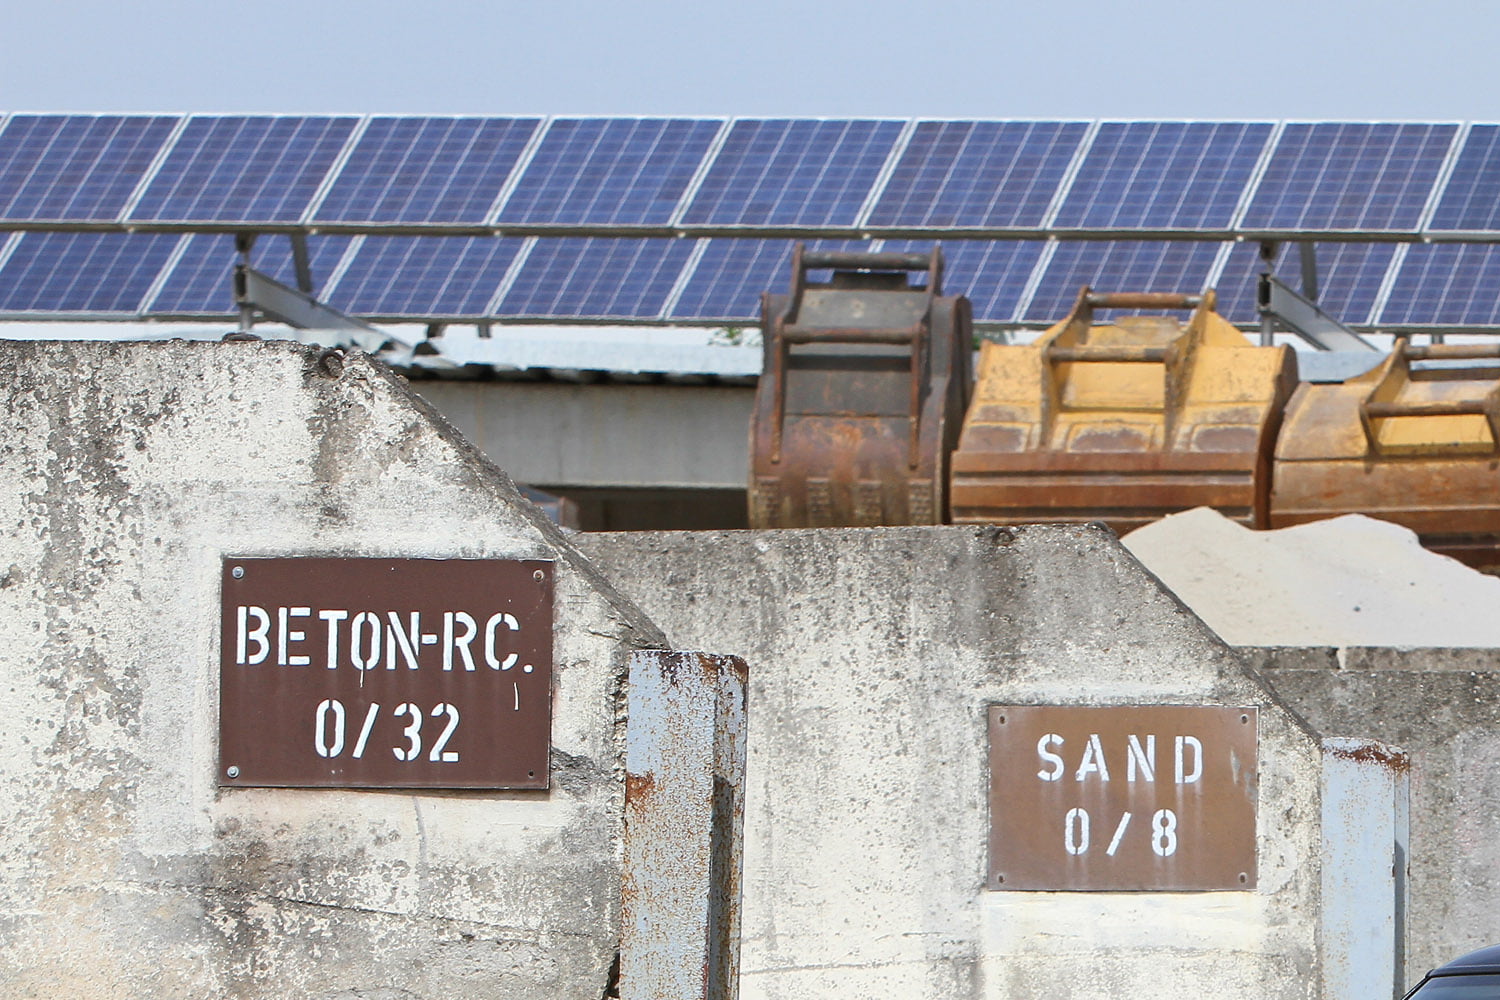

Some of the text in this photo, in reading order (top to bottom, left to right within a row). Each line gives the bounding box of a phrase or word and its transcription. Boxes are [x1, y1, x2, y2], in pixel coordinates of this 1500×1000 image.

[235, 605, 534, 673] BETON-RC.
[314, 699, 461, 762] 0/32
[1036, 733, 1204, 784] SAND
[1064, 807, 1178, 857] 0/8
